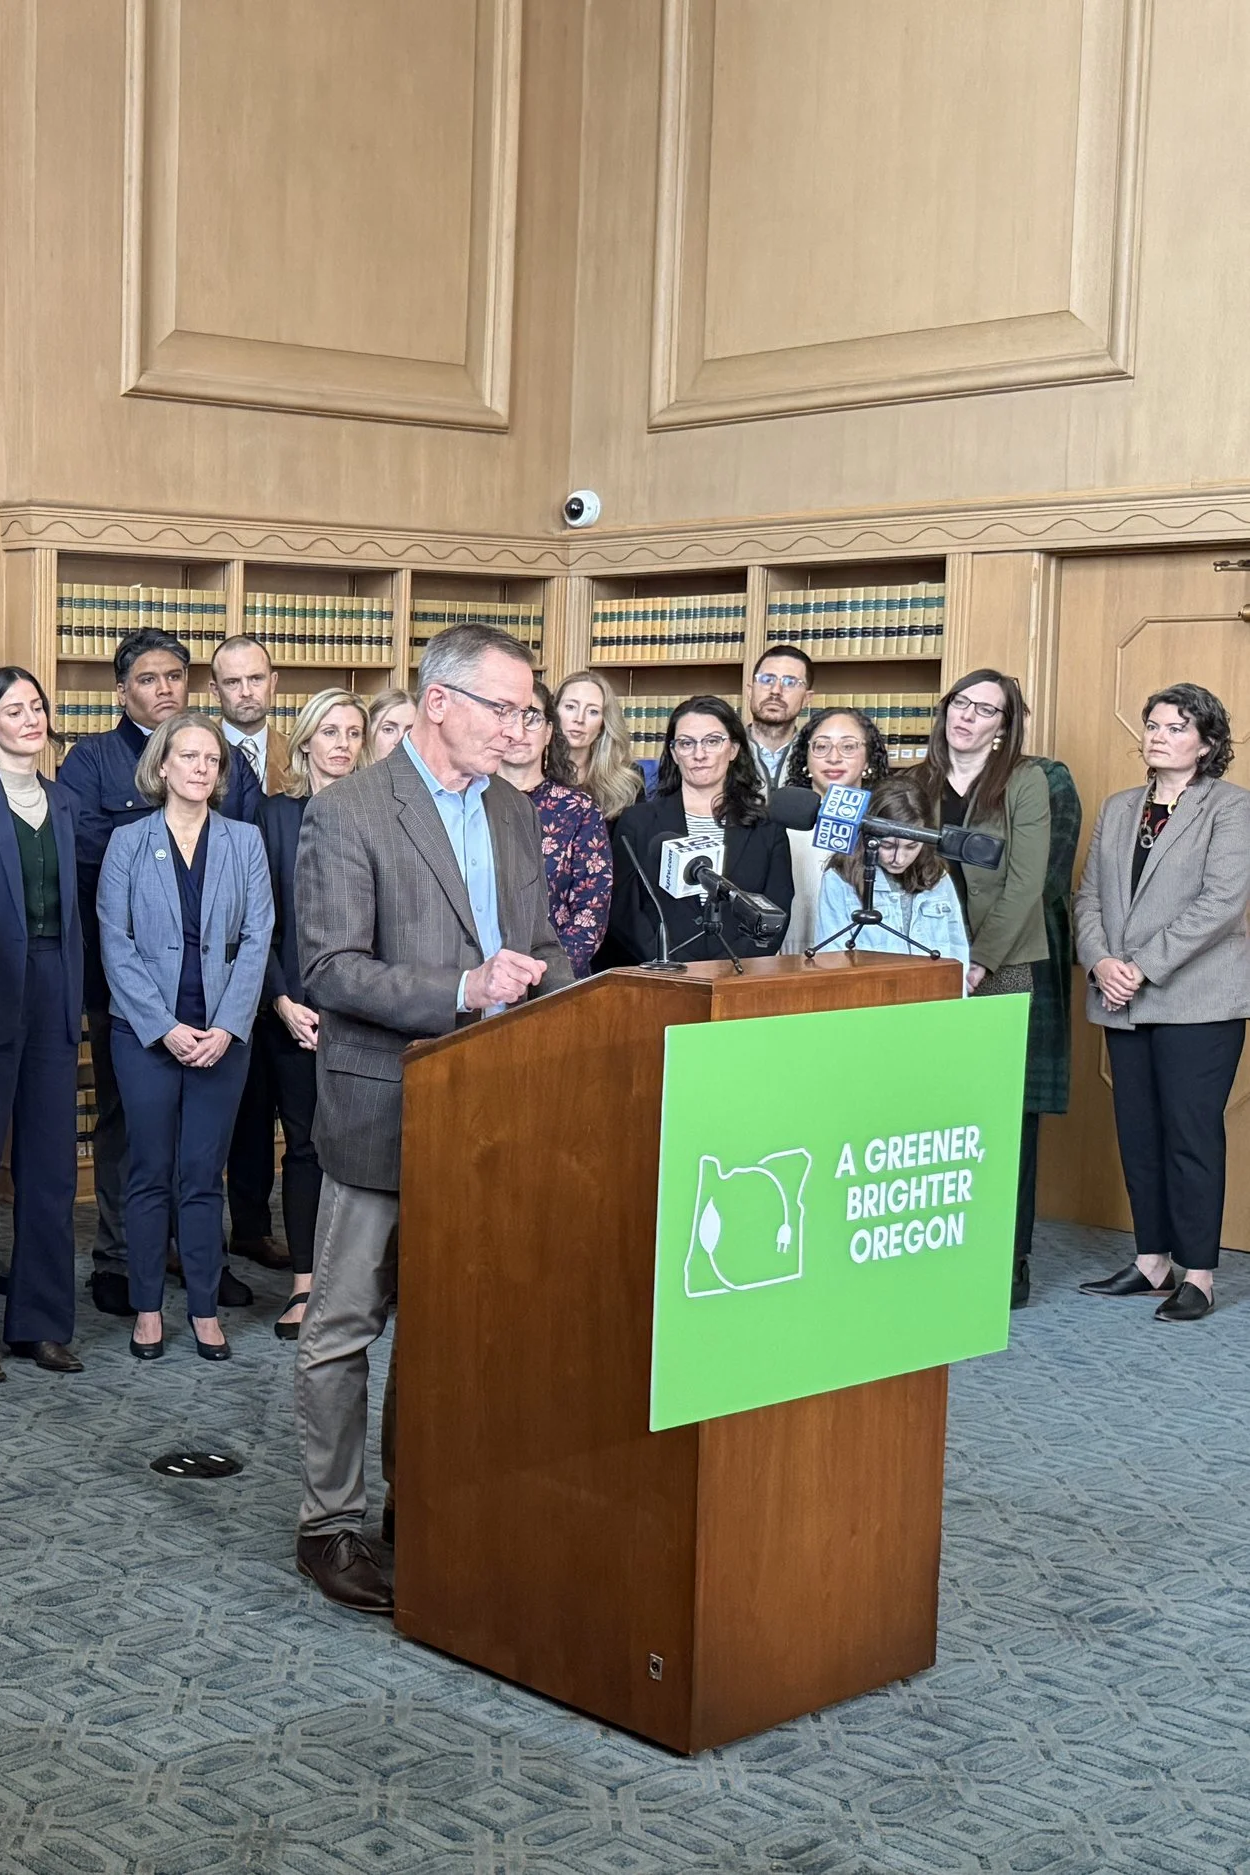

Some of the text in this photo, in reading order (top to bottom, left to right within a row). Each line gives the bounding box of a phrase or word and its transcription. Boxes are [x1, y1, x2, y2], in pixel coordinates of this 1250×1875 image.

[827, 789, 842, 813] KOIN
[819, 821, 831, 845] KOIN
[664, 849, 674, 891] kptv.com
[834, 1125, 986, 1179] A GREENER,
[846, 1168, 973, 1221] BRIGHTER
[849, 1211, 965, 1264] OREGON
